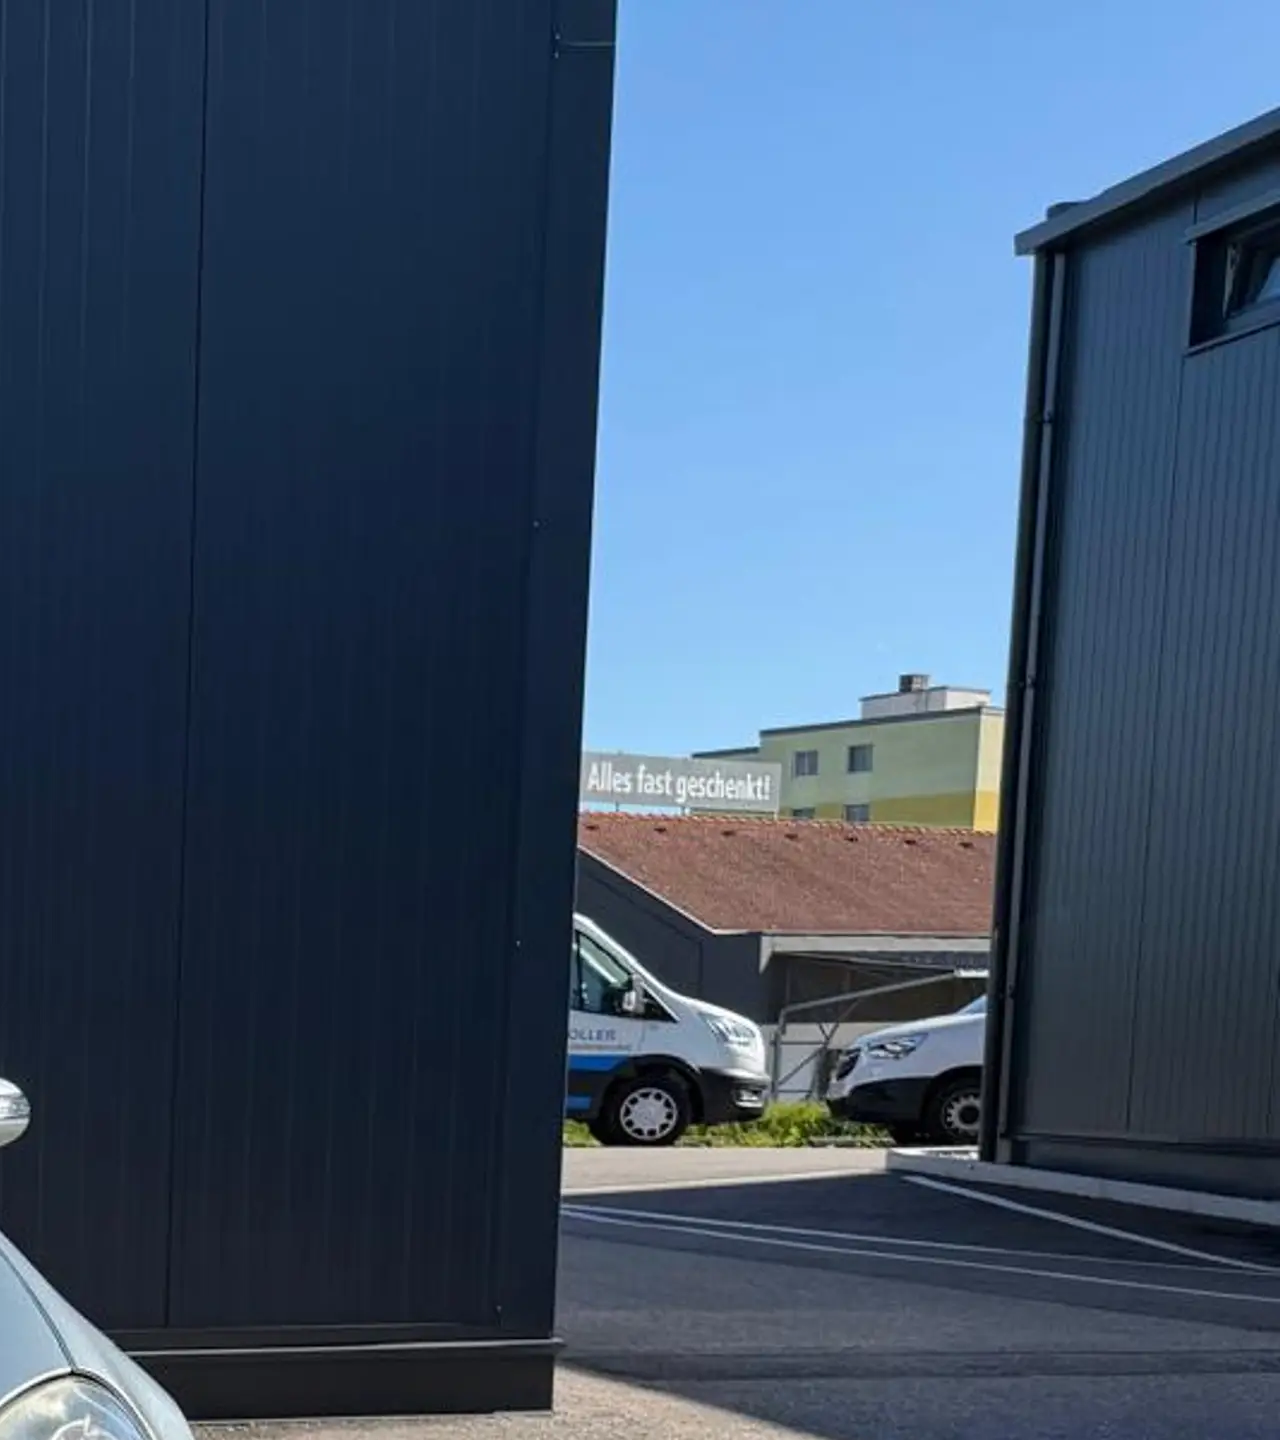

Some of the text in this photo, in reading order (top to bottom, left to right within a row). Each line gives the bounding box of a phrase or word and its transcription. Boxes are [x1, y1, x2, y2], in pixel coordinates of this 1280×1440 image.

[587, 761, 772, 803] Alles fast geschenkt!
